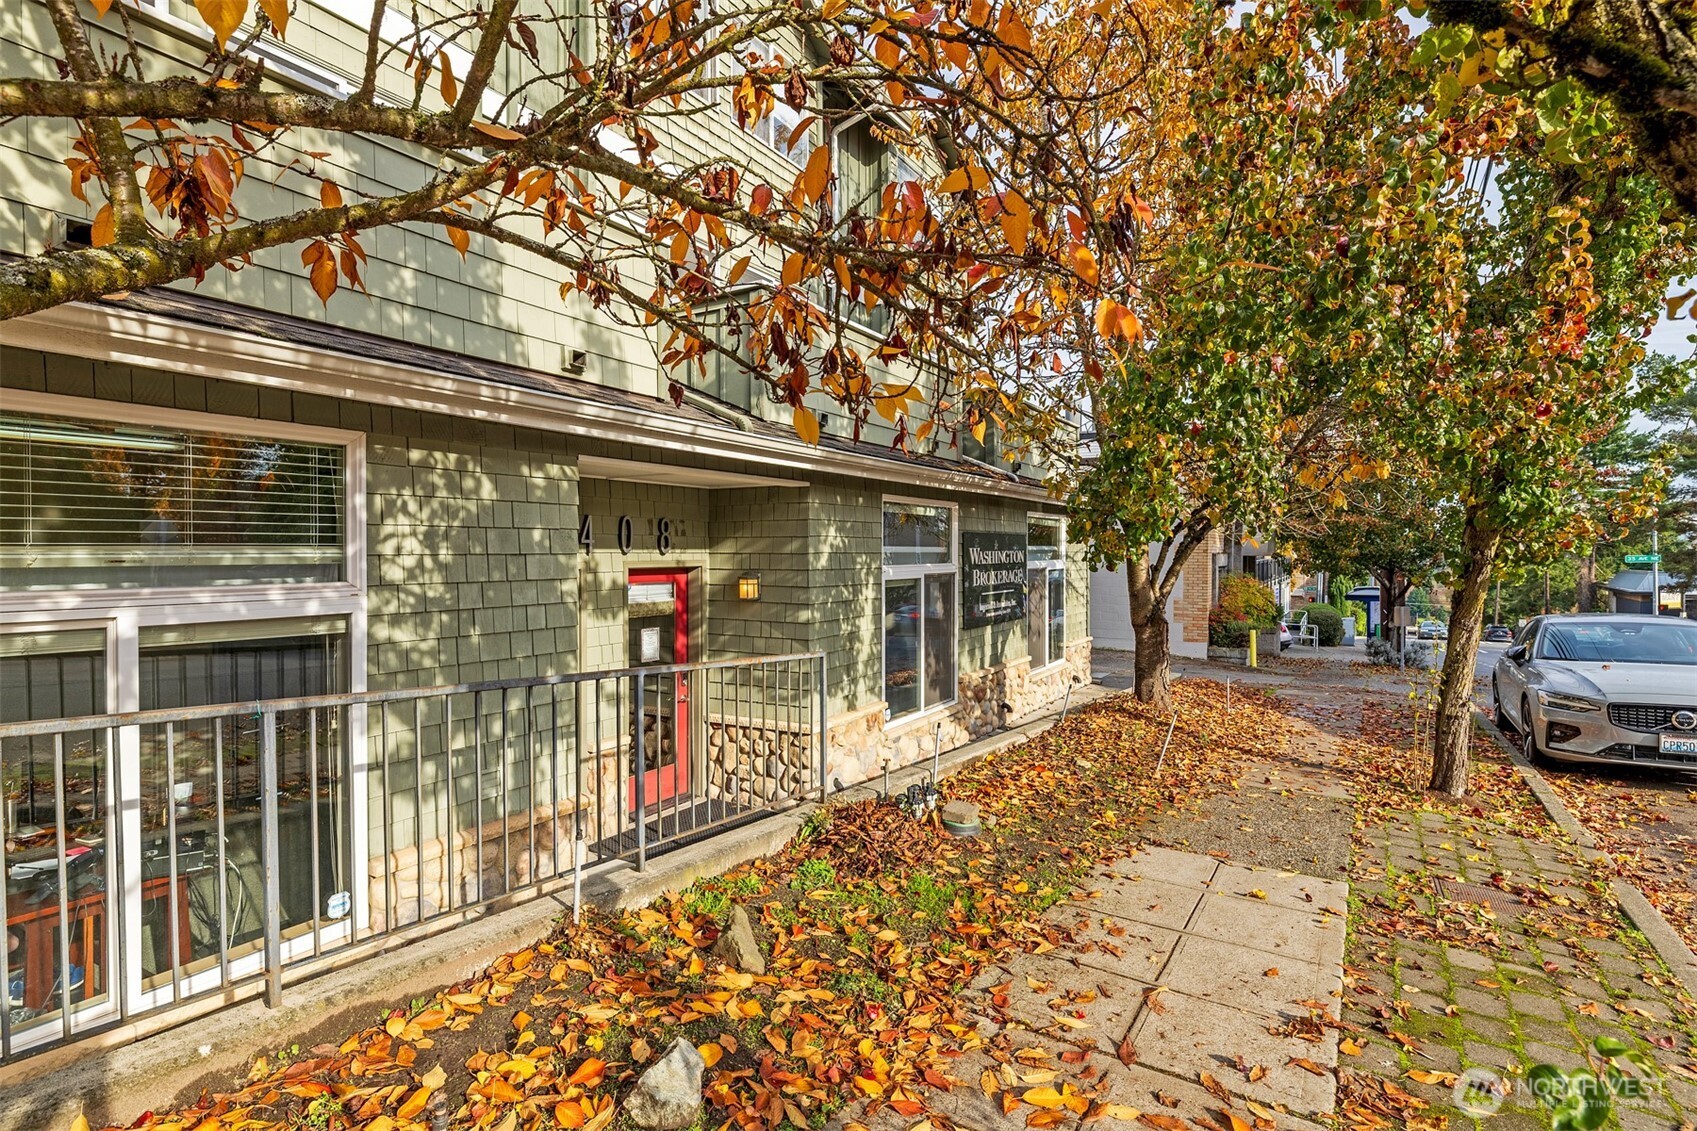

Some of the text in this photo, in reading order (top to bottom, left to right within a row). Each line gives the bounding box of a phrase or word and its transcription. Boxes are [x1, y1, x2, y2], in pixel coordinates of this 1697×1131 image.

[580, 514, 673, 556] 408
[968, 547, 1025, 565] WASHINGTON
[972, 569, 1023, 587] BROKERAGE
